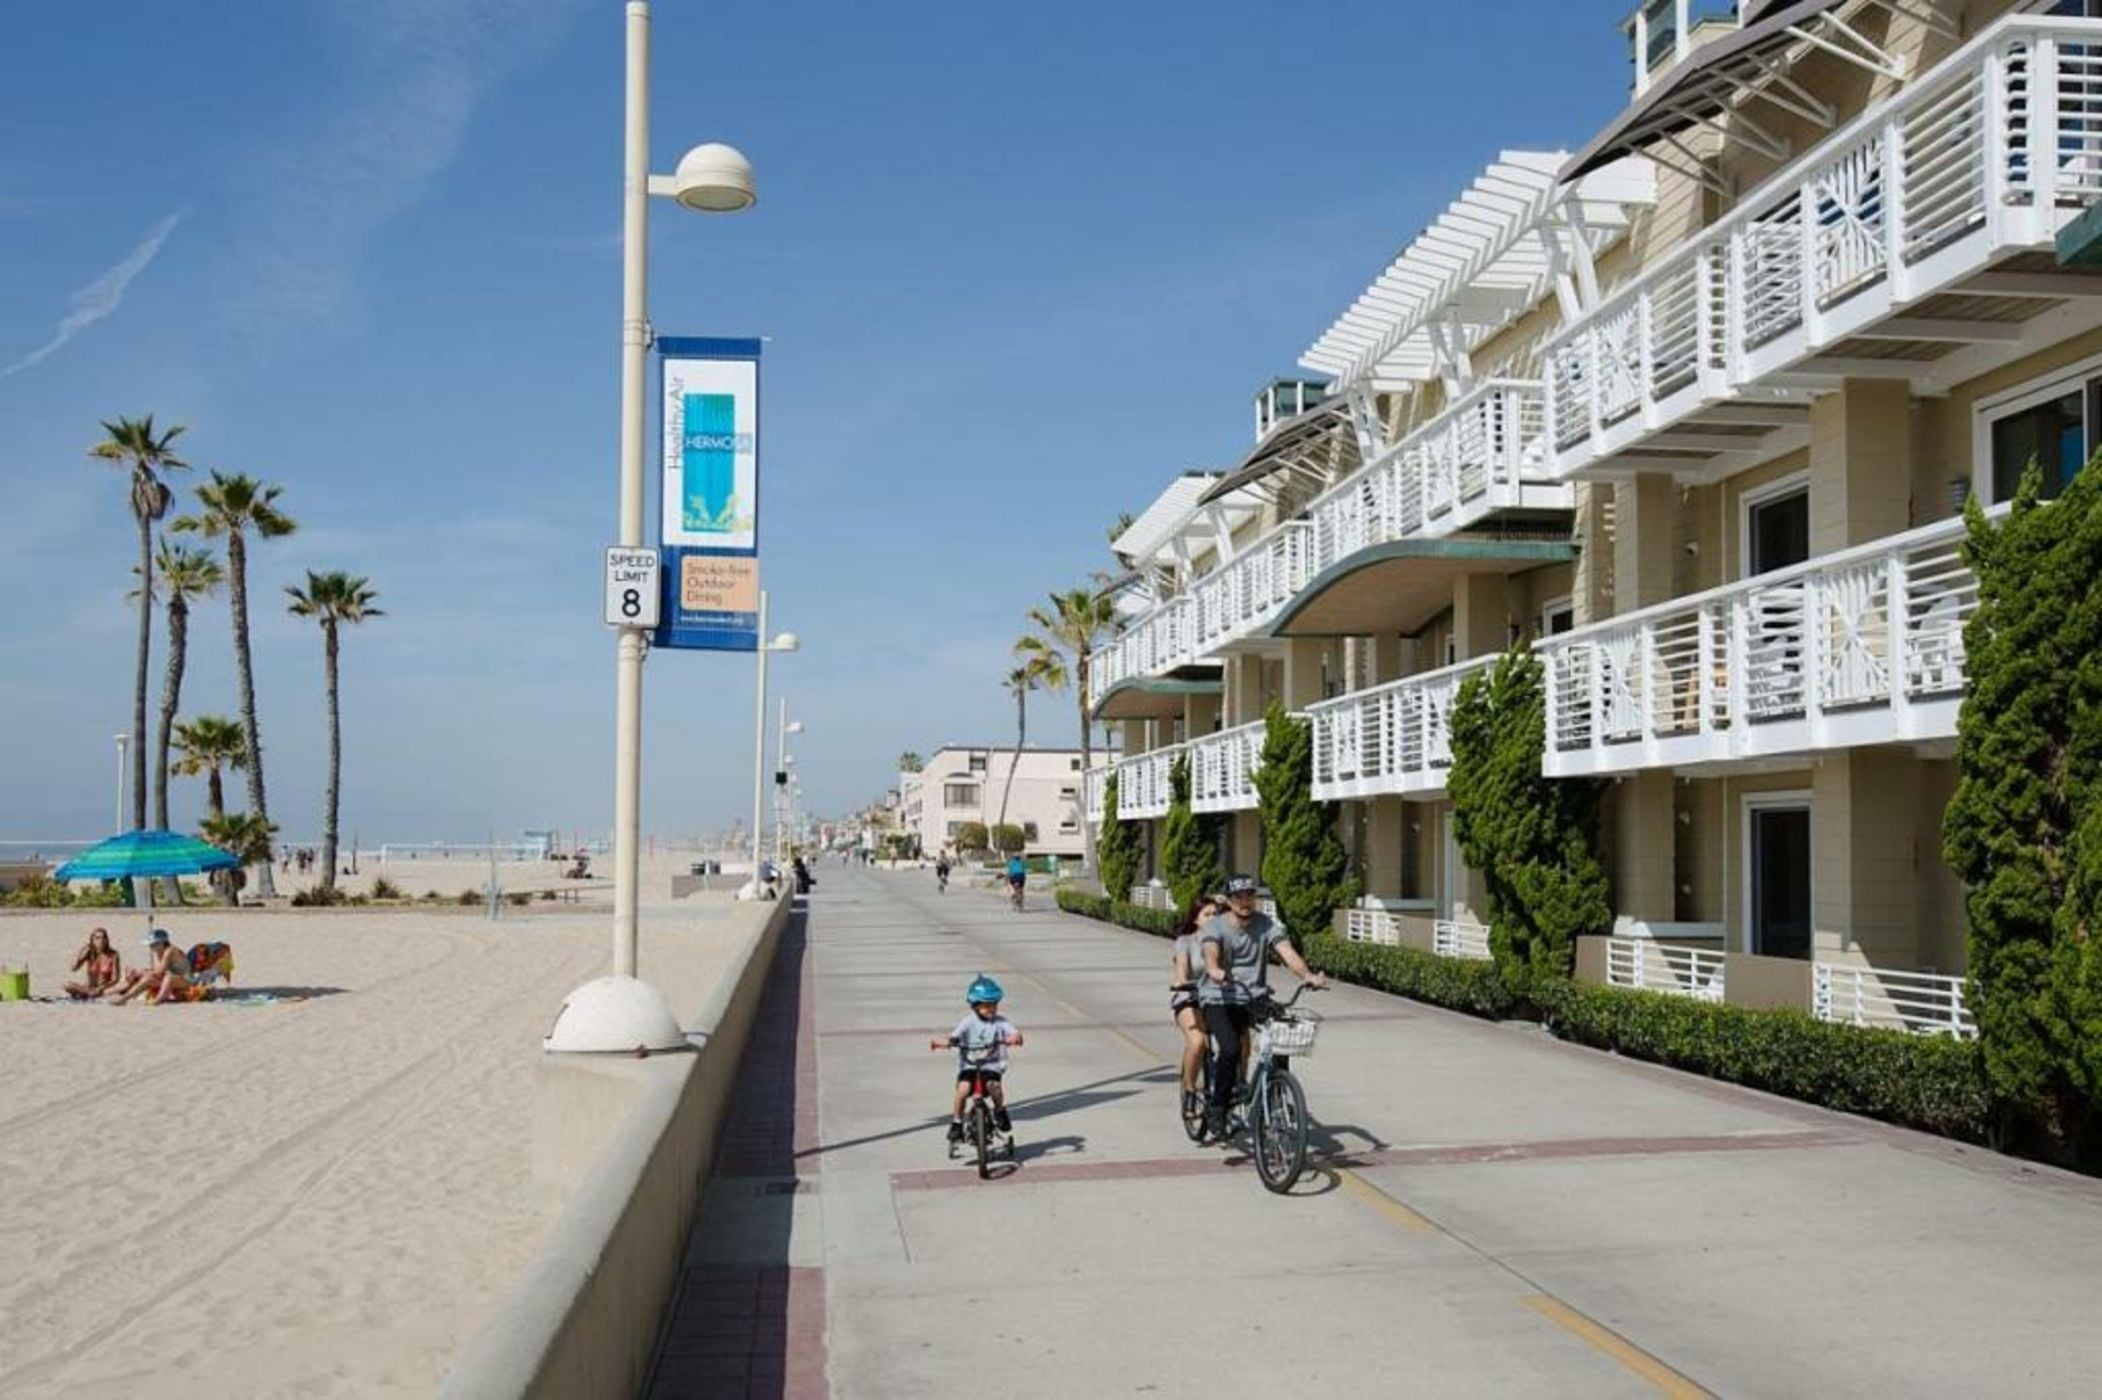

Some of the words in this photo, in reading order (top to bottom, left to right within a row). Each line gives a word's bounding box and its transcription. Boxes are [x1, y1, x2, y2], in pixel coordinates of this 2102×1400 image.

[669, 377, 683, 401] Air
[610, 555, 655, 567] SPEED
[615, 571, 648, 582] LIMIT
[687, 577, 736, 588] Outdoor
[622, 589, 641, 617] 8
[687, 591, 722, 606] Dining
